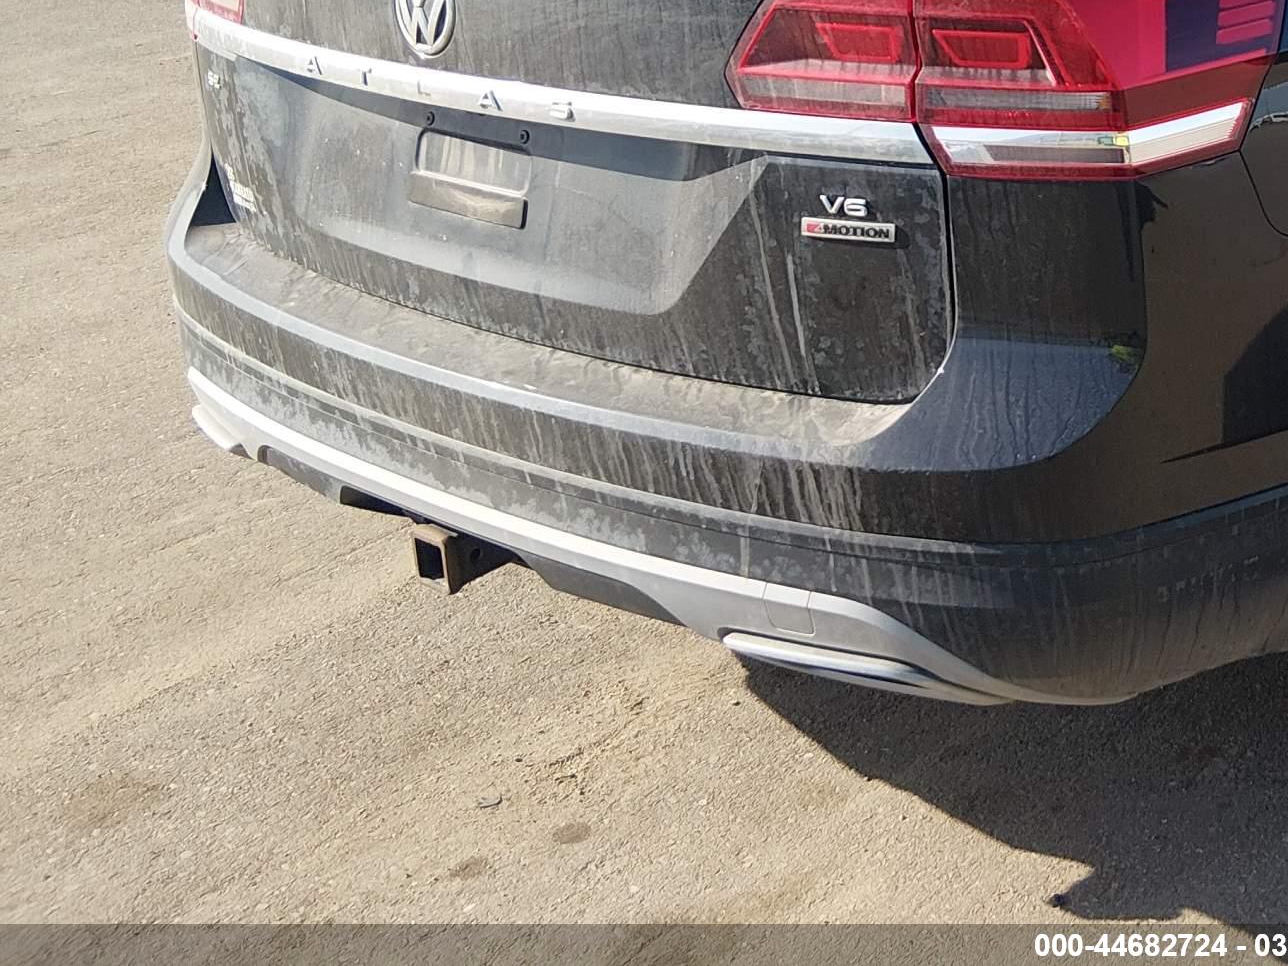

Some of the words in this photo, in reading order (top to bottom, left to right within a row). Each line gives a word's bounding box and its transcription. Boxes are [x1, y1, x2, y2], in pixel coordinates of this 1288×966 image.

[306, 55, 576, 122] ATLAS
[819, 194, 868, 217] V6
[806, 222, 890, 239] 4MOTION
